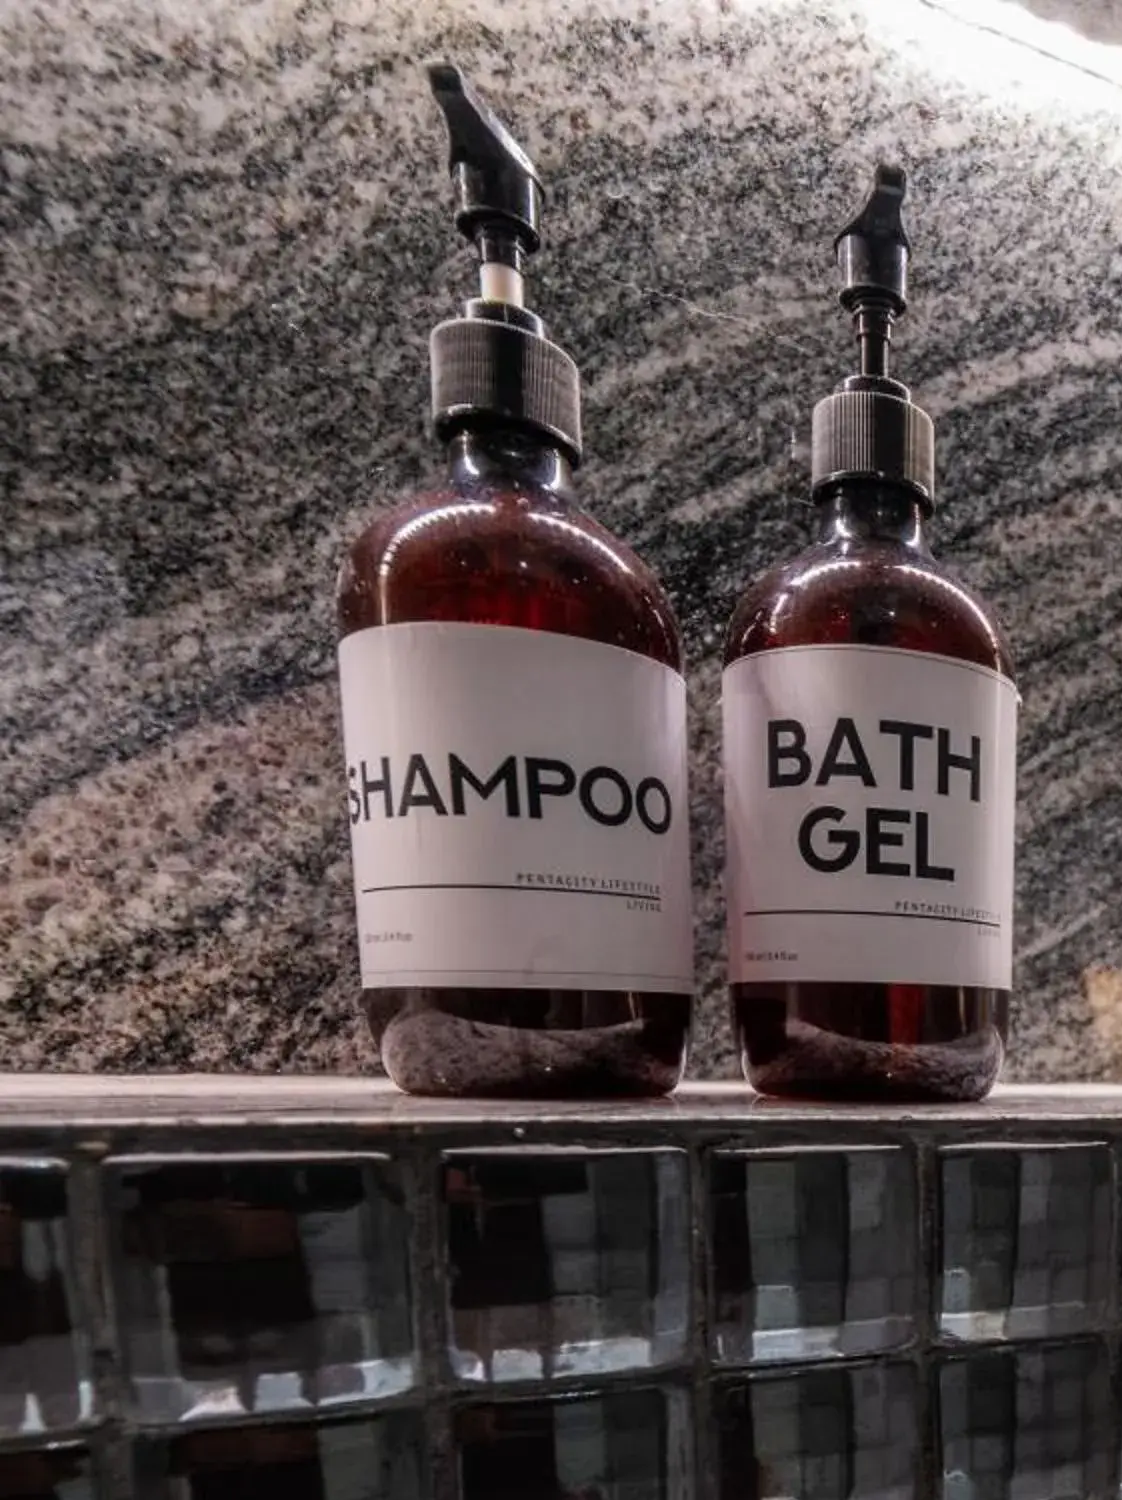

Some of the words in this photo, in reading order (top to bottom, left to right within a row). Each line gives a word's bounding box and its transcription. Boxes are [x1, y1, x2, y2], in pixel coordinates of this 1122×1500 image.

[348, 753, 672, 835] SHAMPOO
[767, 717, 981, 801] BATH
[797, 806, 955, 882] GEL
